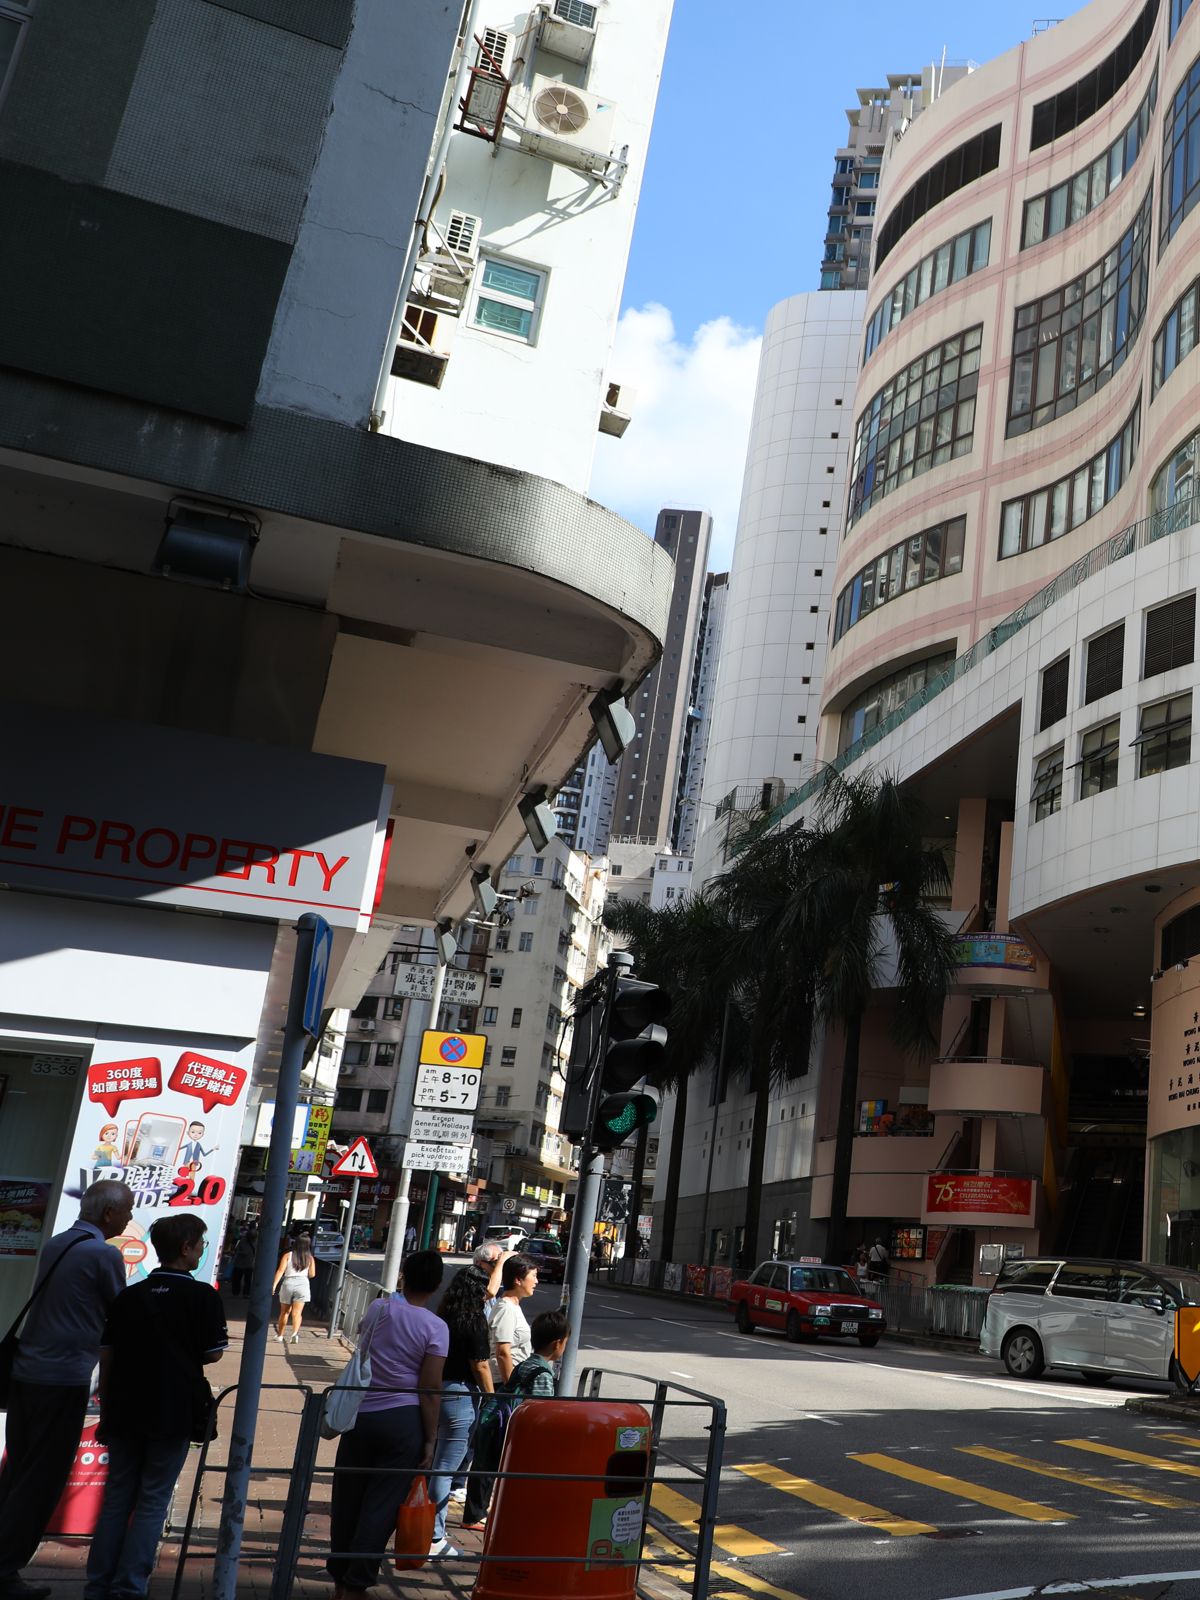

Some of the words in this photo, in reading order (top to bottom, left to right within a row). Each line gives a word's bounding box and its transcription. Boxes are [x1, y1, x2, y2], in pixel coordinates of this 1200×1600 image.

[0, 805, 43, 850] E
[56, 814, 349, 892] PROPERTY
[405, 973, 477, 991] 張志中醫師
[1184, 1028, 1197, 1037] WONG
[1183, 1058, 1196, 1067] WONG
[33, 1062, 77, 1076] 33-35
[106, 1066, 143, 1080] 360度
[186, 1061, 238, 1085] 代理線上
[420, 1075, 439, 1083] 上午
[442, 1072, 477, 1086] 8-10
[92, 1077, 158, 1094] 如置身現場
[180, 1072, 234, 1098] 同步睇樓
[1186, 1087, 1200, 1096] CHUNG
[418, 1094, 436, 1103] 下午
[432, 1114, 455, 1123] Except
[415, 1120, 440, 1128] General
[441, 1121, 470, 1131] Holidays
[413, 1128, 468, 1138] 公眾假期例外
[420, 1145, 444, 1154] Except
[427, 1152, 452, 1161] up/drop
[406, 1159, 464, 1170] 的士上落客除外
[134, 1189, 170, 1209] IDE
